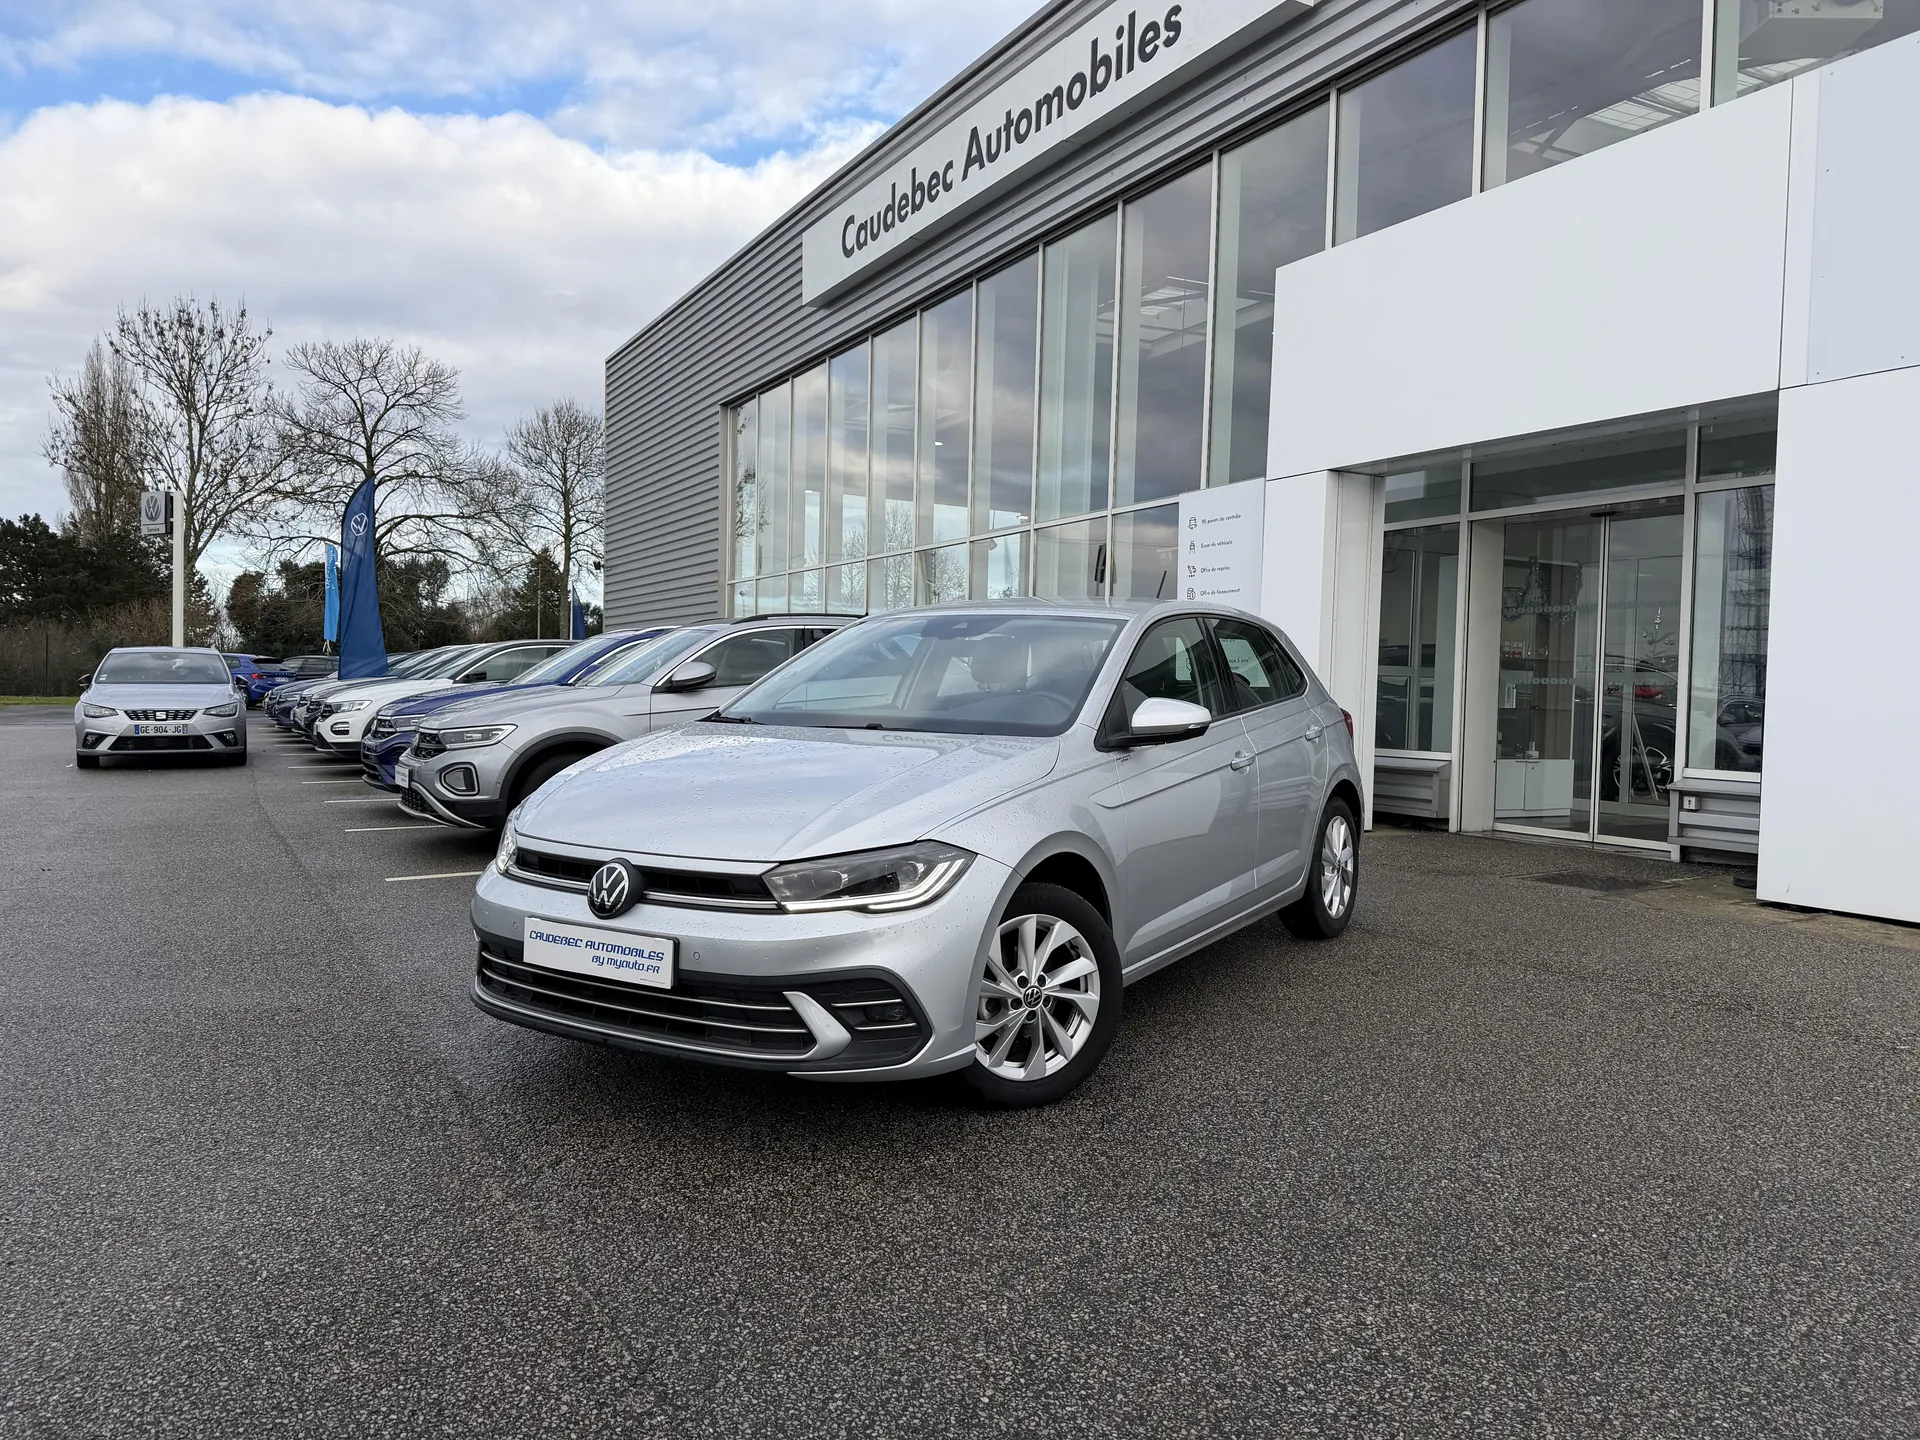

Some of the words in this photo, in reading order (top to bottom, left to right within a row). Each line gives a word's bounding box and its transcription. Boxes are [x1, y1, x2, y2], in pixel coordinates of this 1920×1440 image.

[842, 159, 955, 259] Caudebec
[961, 3, 1183, 183] Automobiles
[140, 725, 182, 734] GE-904-JG
[529, 930, 583, 948] CAUDEBEC
[584, 940, 664, 962] AUTOMOBILES
